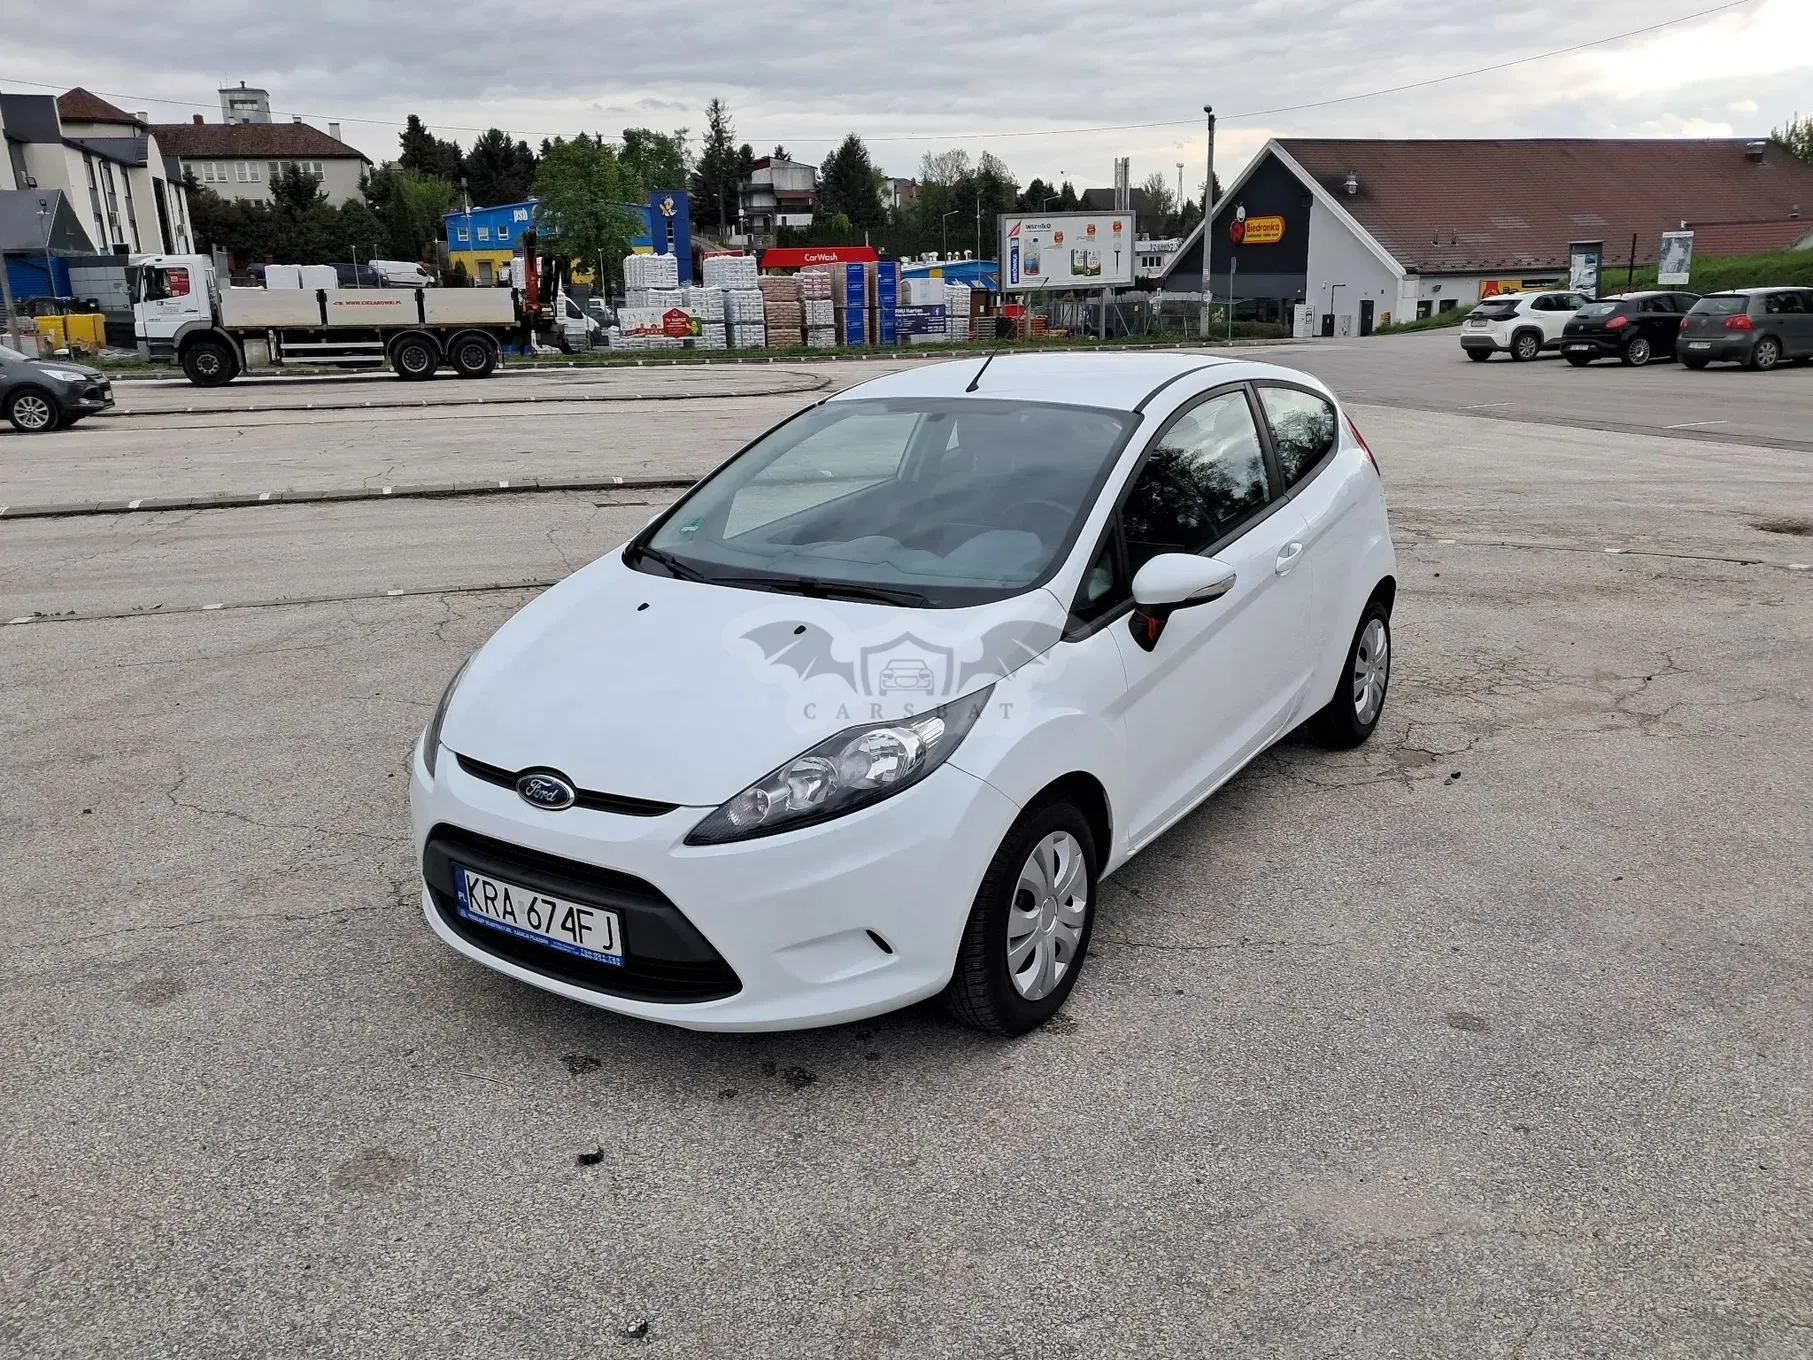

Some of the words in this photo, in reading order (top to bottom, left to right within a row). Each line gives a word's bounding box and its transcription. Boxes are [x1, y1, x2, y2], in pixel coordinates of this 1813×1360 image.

[1246, 221, 1280, 232] Biedronka
[804, 252, 838, 261] CarWash
[525, 779, 559, 801] Ford
[457, 891, 467, 903] PL
[466, 874, 517, 924] KRA
[526, 896, 614, 951] 674FJ
